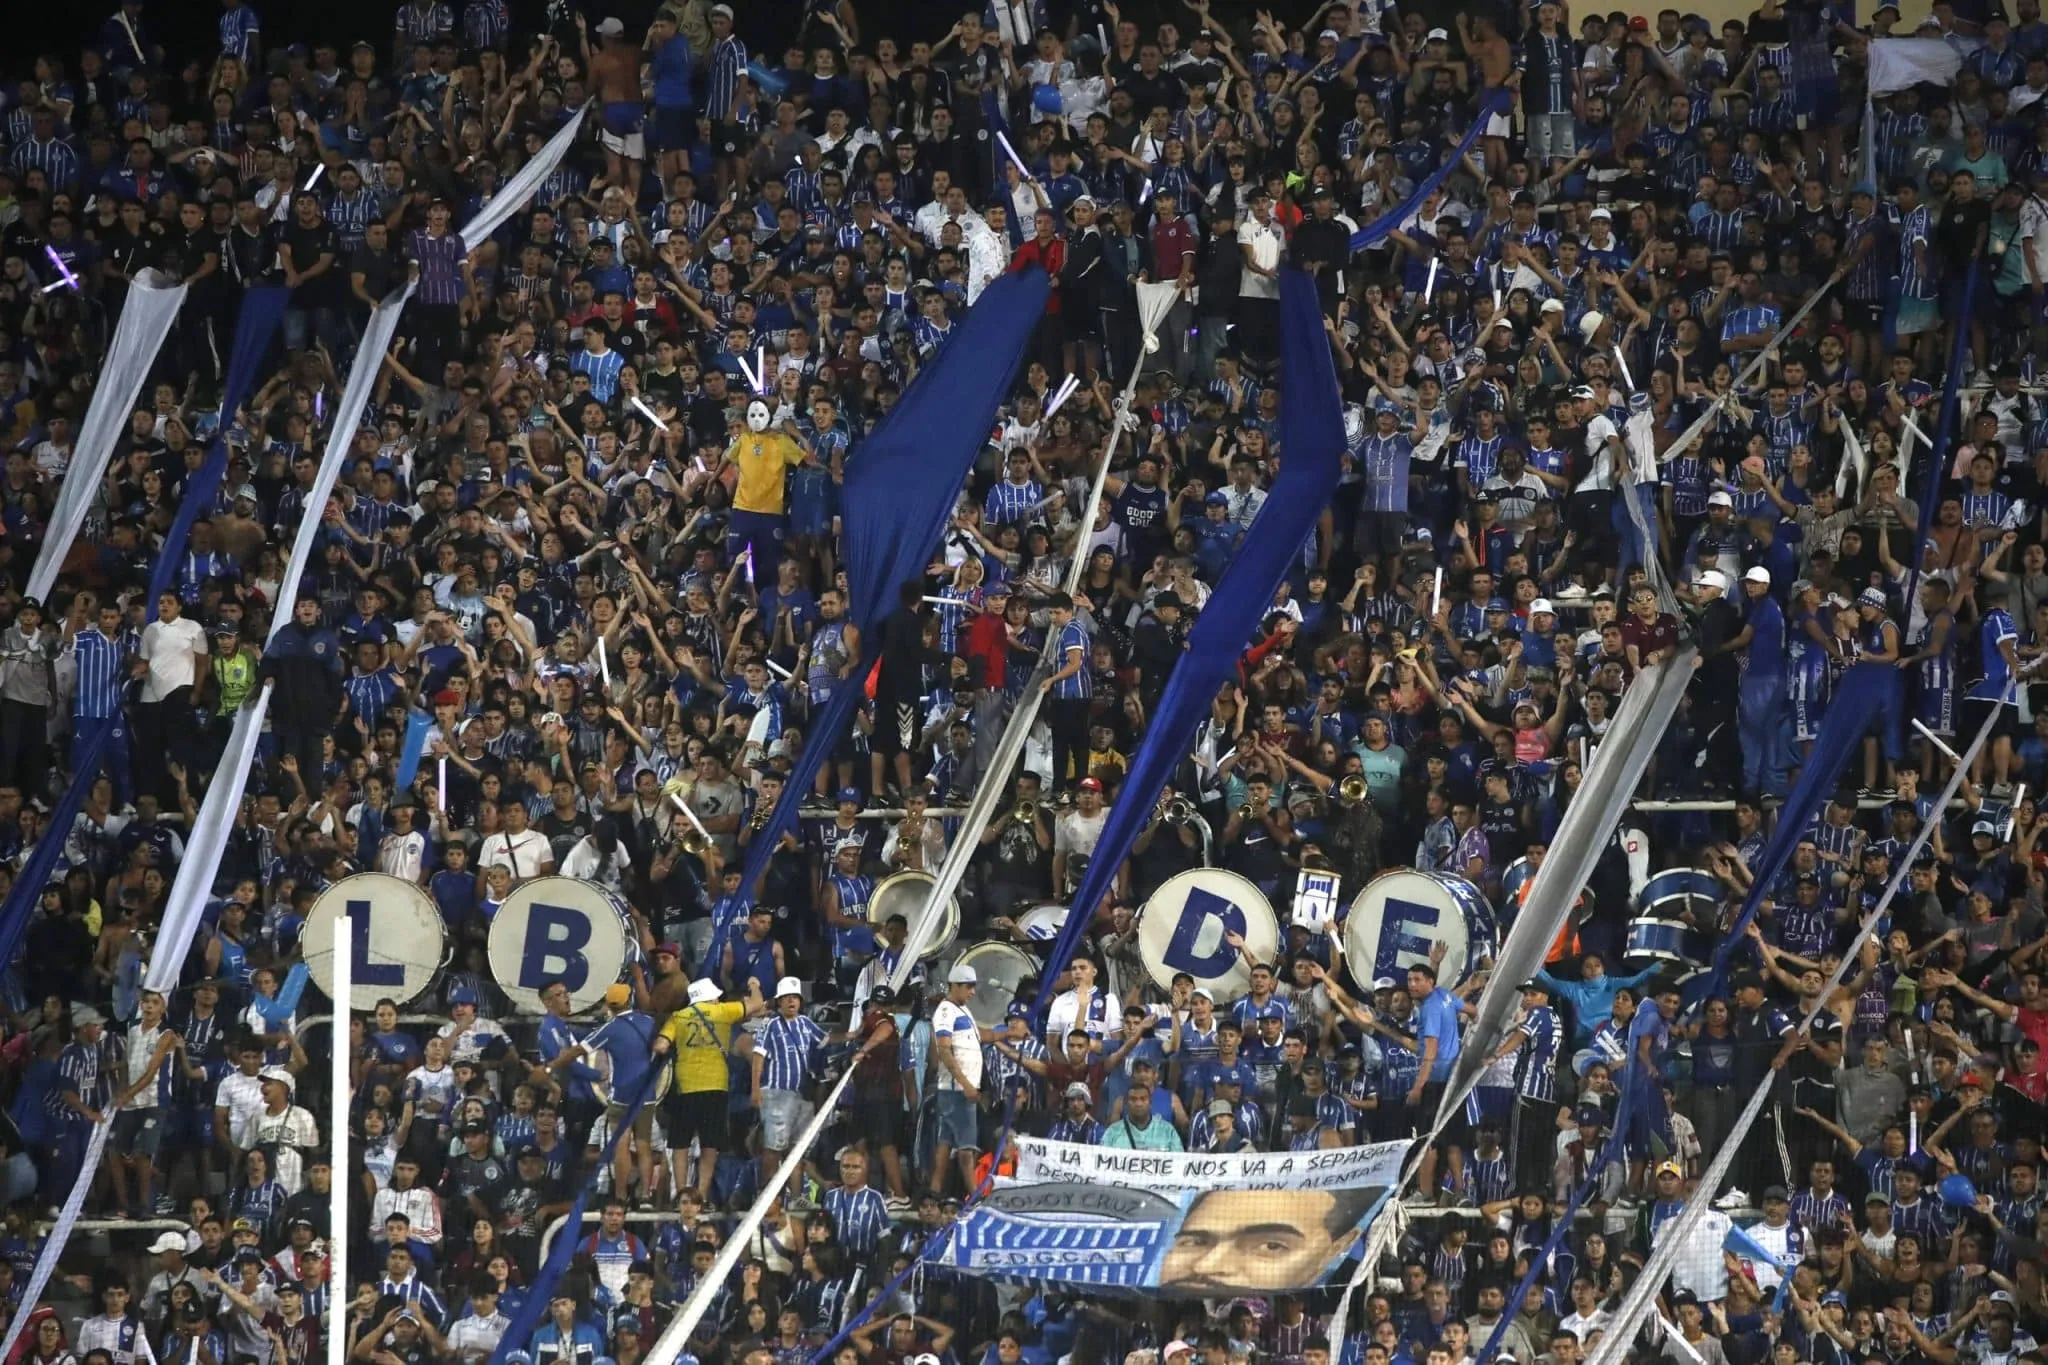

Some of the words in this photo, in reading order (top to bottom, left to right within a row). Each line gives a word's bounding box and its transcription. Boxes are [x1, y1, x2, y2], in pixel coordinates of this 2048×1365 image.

[346, 900, 405, 986] L
[519, 902, 592, 993] B
[1163, 886, 1247, 979] D
[1372, 897, 1439, 982] E
[1026, 1143, 1047, 1157] NI
[1062, 1149, 1081, 1165] LA
[1097, 1153, 1173, 1174] MUERTE
[1183, 1159, 1228, 1176] NOS
[1241, 1160, 1265, 1175] VA
[1280, 1158, 1294, 1175] A
